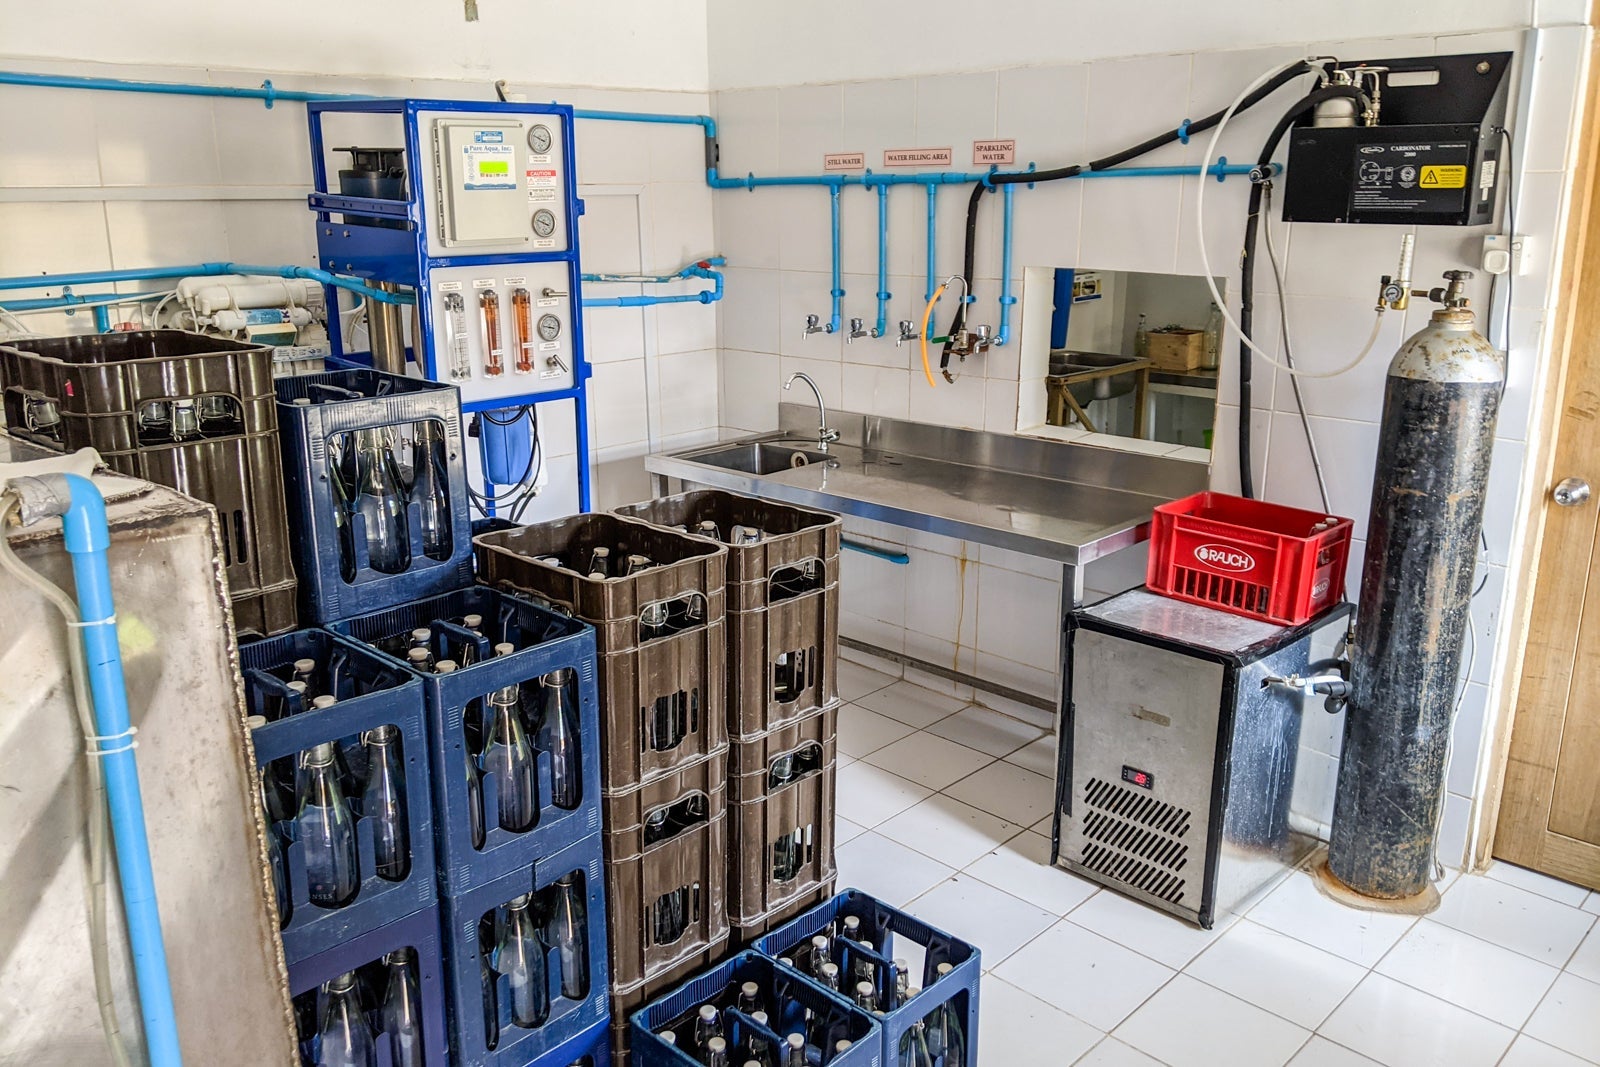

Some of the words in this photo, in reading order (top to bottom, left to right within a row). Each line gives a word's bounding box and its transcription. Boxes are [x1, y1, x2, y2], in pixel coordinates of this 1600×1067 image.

[484, 145, 500, 153] Aqua,
[976, 144, 1013, 152] SPARKLING
[1208, 550, 1249, 568] RAUCH
